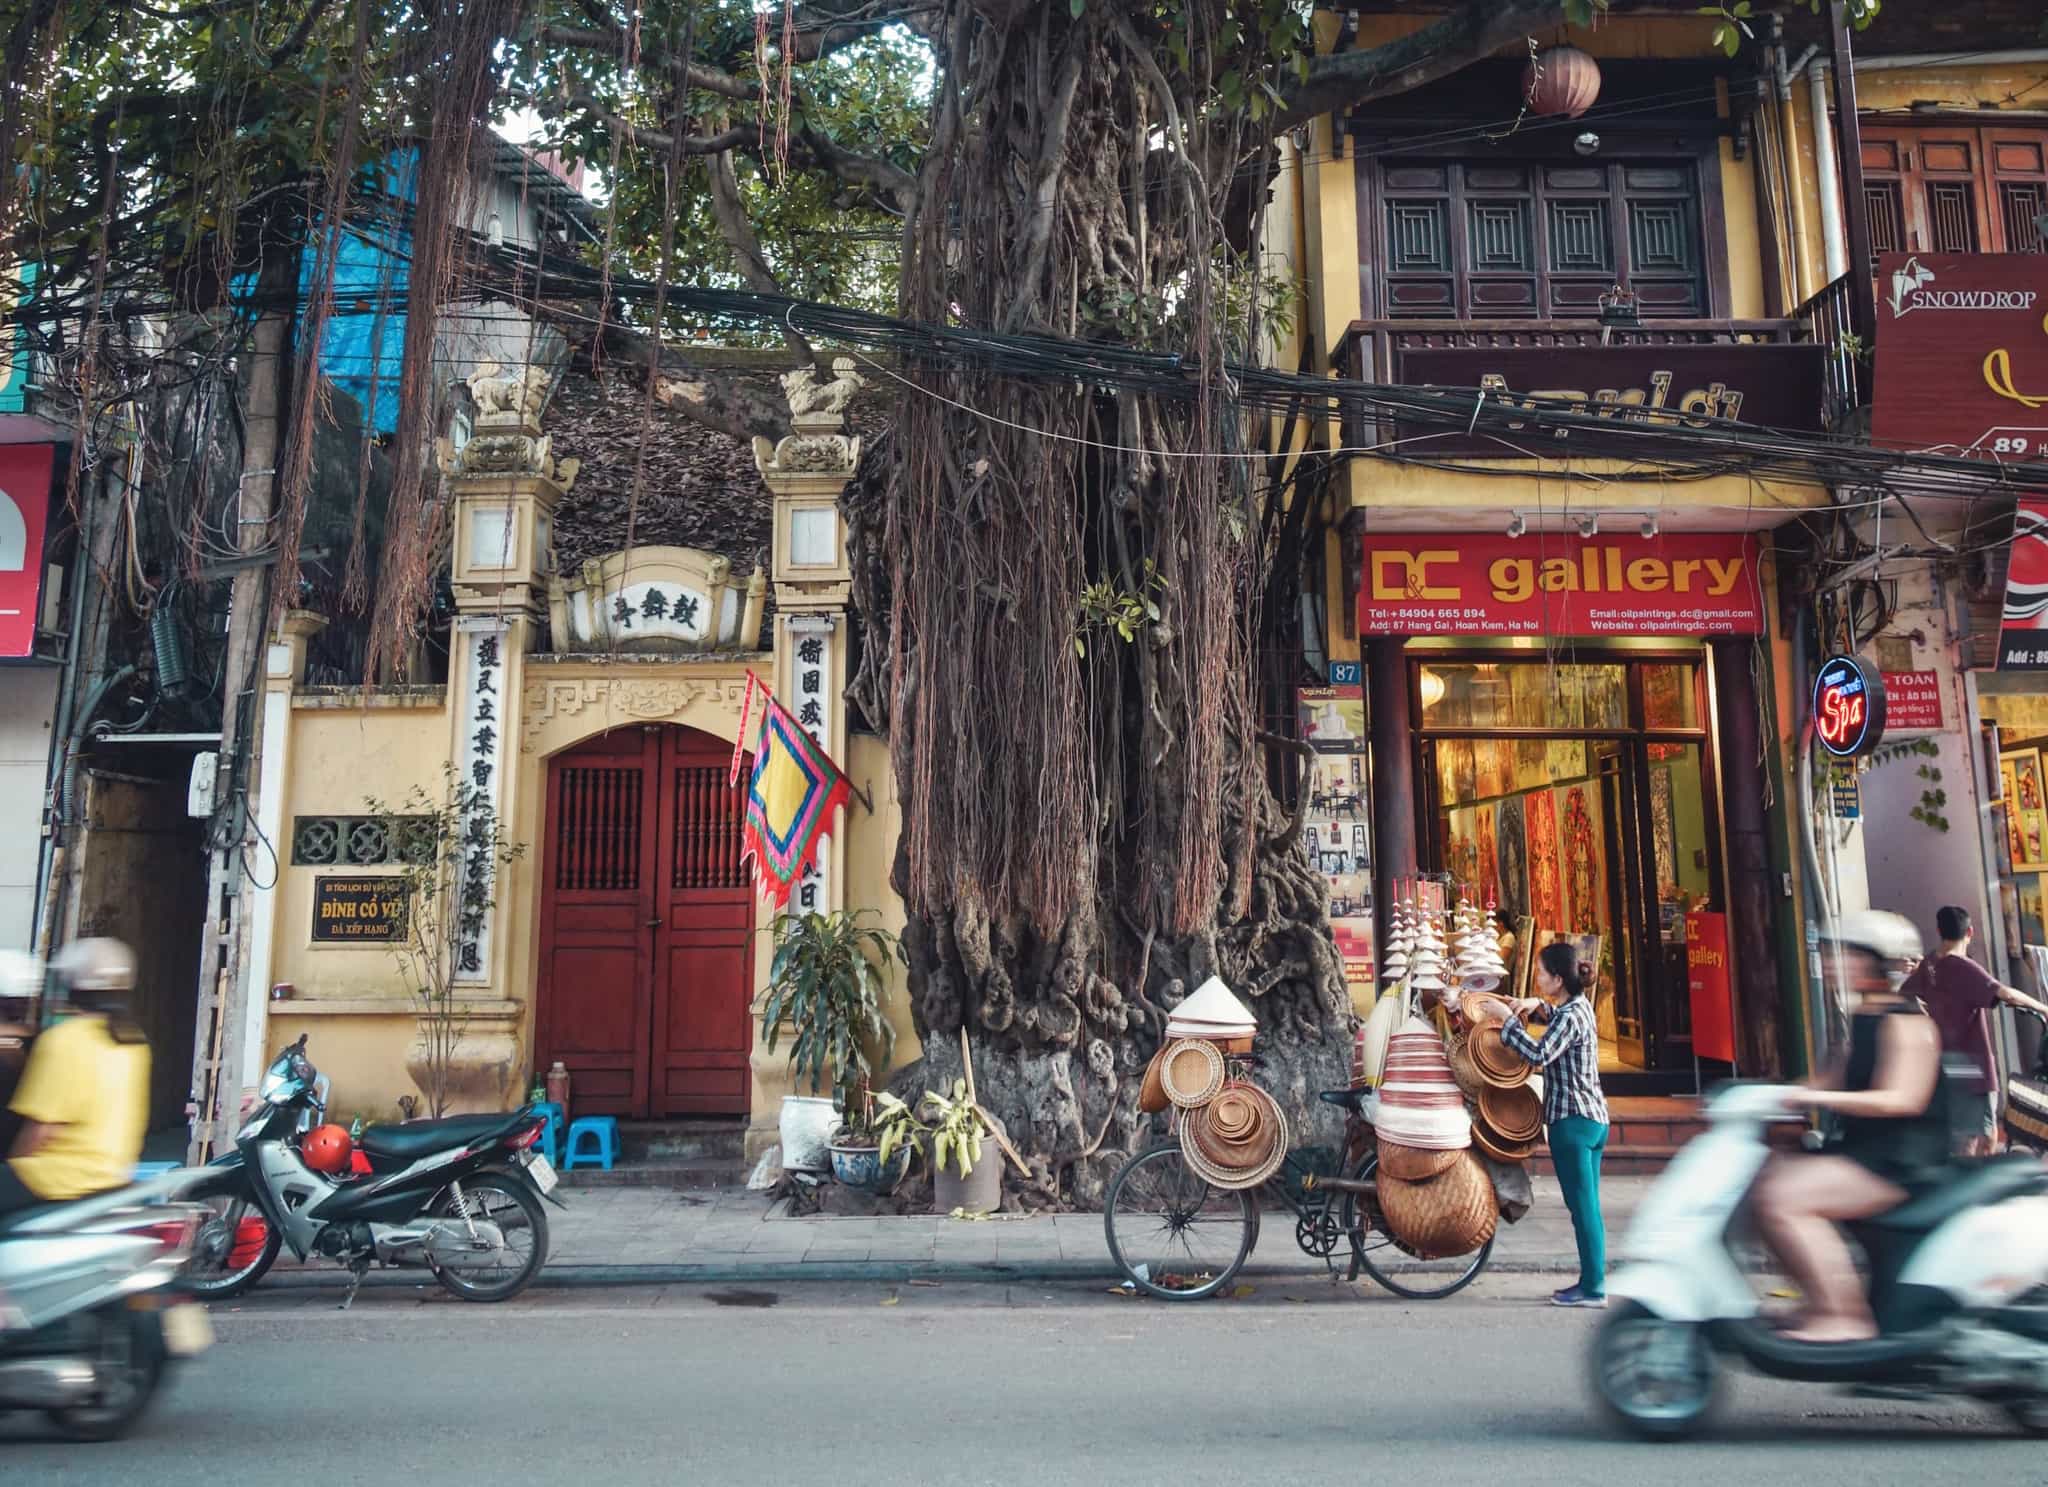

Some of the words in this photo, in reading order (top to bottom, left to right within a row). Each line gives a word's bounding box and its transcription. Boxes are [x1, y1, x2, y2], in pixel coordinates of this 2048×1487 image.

[1911, 291, 2036, 309] SNOWDROP
[1993, 438, 2027, 453] 89
[1489, 547, 1743, 602] gallery
[1438, 608, 1460, 618] 665
[1463, 608, 1486, 618] 894
[1393, 621, 1404, 630] 87
[1407, 621, 1431, 632] Hang
[1455, 621, 1478, 630] Hoan
[1508, 621, 1520, 630] Ha
[2006, 650, 2028, 664] Add
[1336, 664, 1355, 681] 87
[1820, 687, 1863, 744] Spa
[321, 898, 356, 918] ĐÌNH
[1688, 946, 1723, 968] gallery
